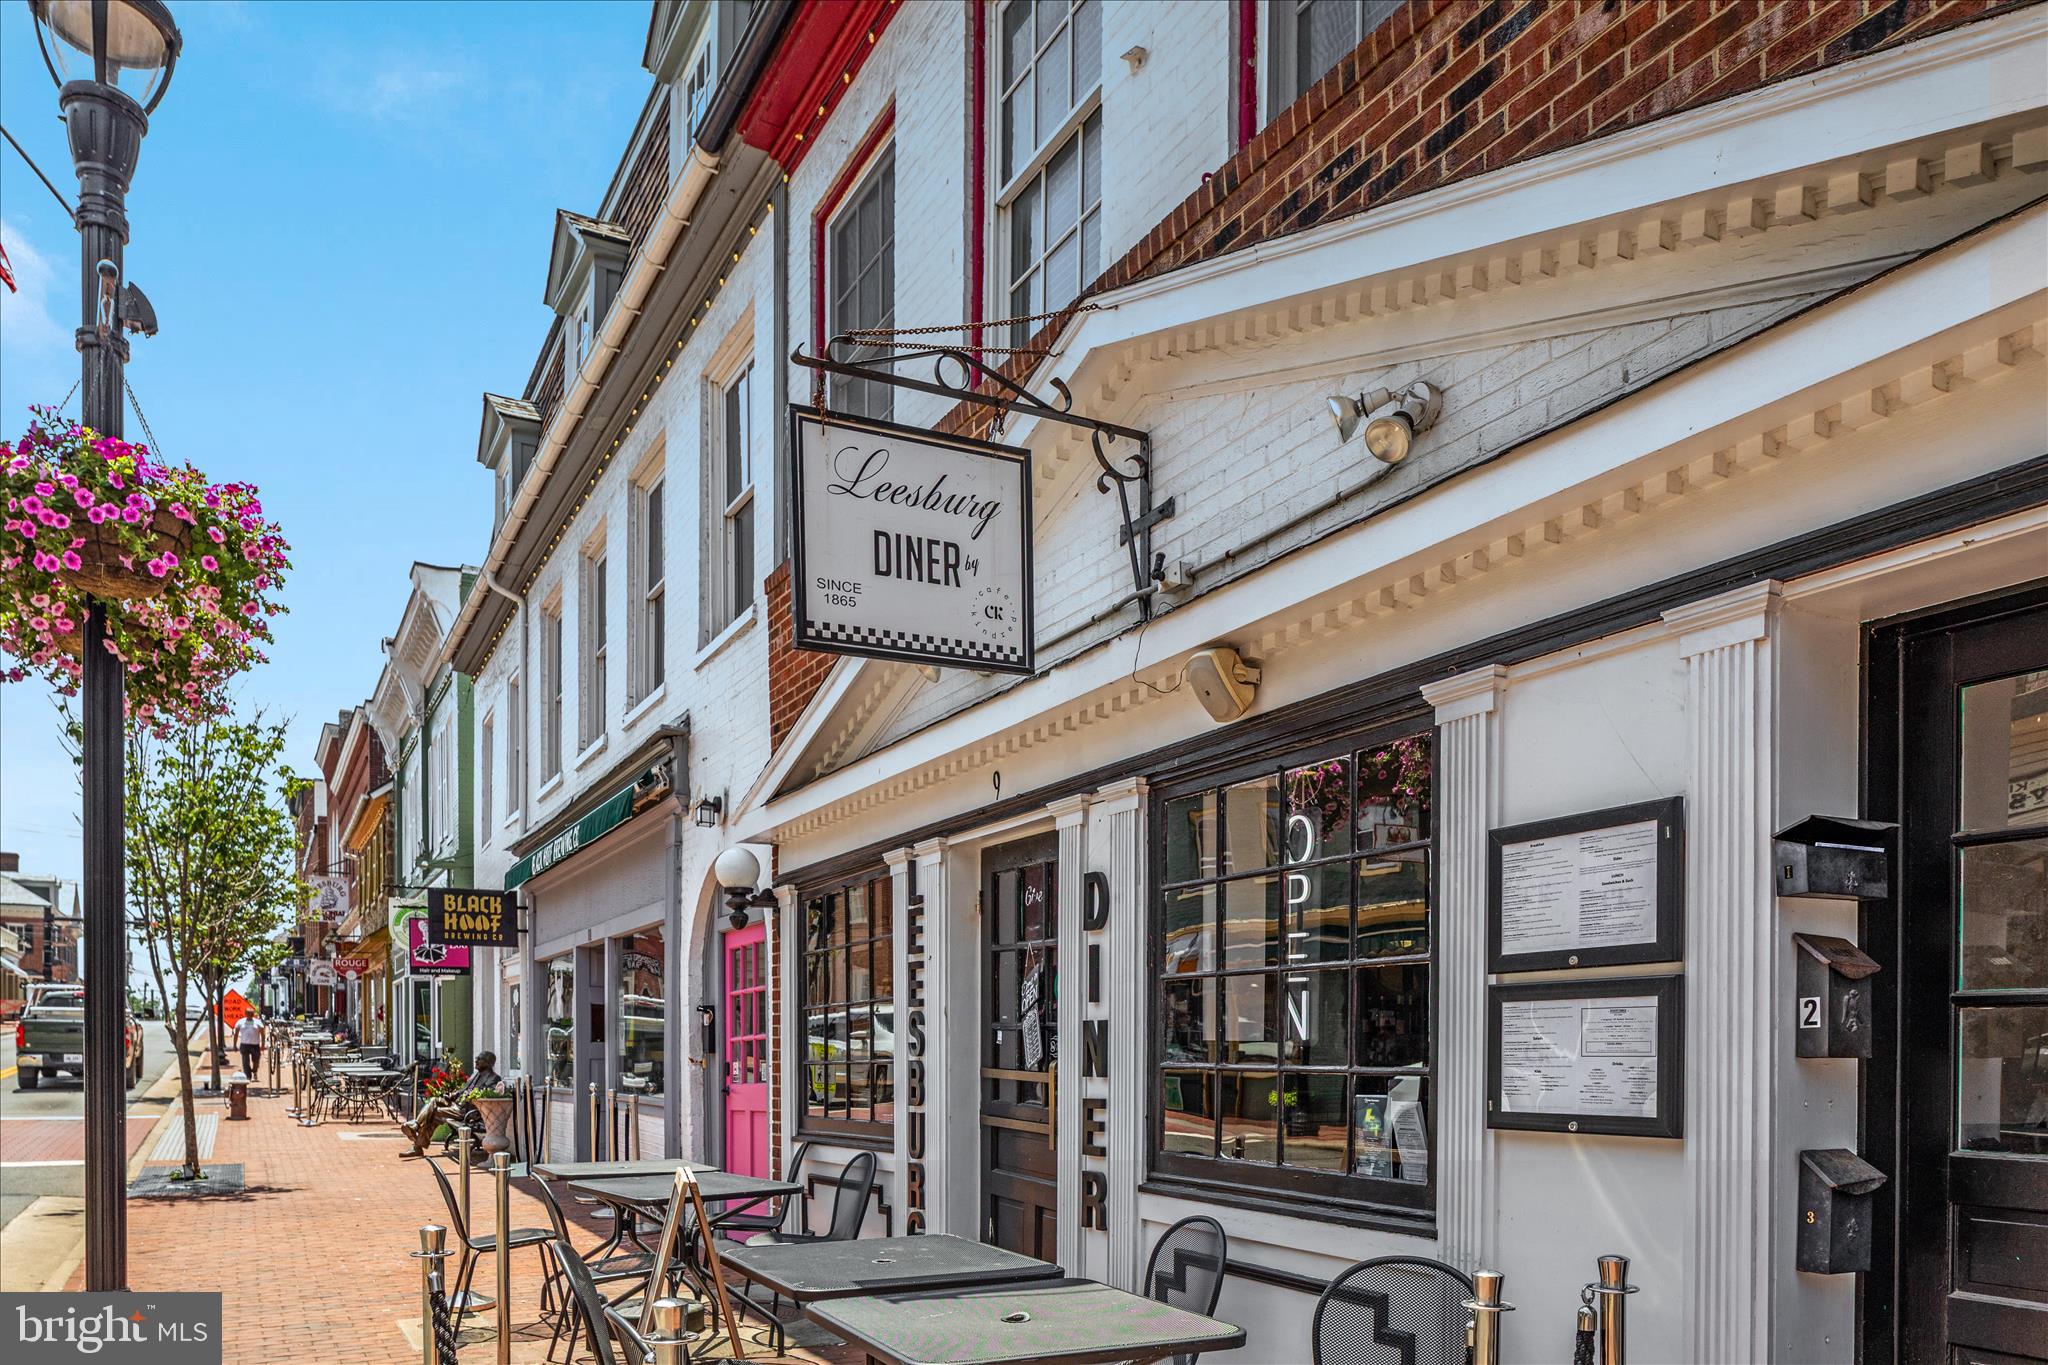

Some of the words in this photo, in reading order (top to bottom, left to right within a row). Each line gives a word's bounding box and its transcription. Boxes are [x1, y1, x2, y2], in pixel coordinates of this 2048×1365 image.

[827, 446, 1001, 541] Leesburg
[873, 529, 961, 588] DINER
[964, 554, 979, 577] by
[816, 577, 862, 595] SINCE
[824, 593, 857, 608] 1865
[993, 771, 1000, 800] 9
[444, 894, 502, 914] BLACK
[444, 912, 502, 933] HOOF
[1288, 813, 1314, 1041] OPEN
[444, 932, 488, 941] BREWING
[335, 959, 367, 967] ROUGE
[1803, 999, 1818, 1026] 2
[1083, 871, 1110, 1231] DINER
[1806, 1210, 1815, 1224] 3
